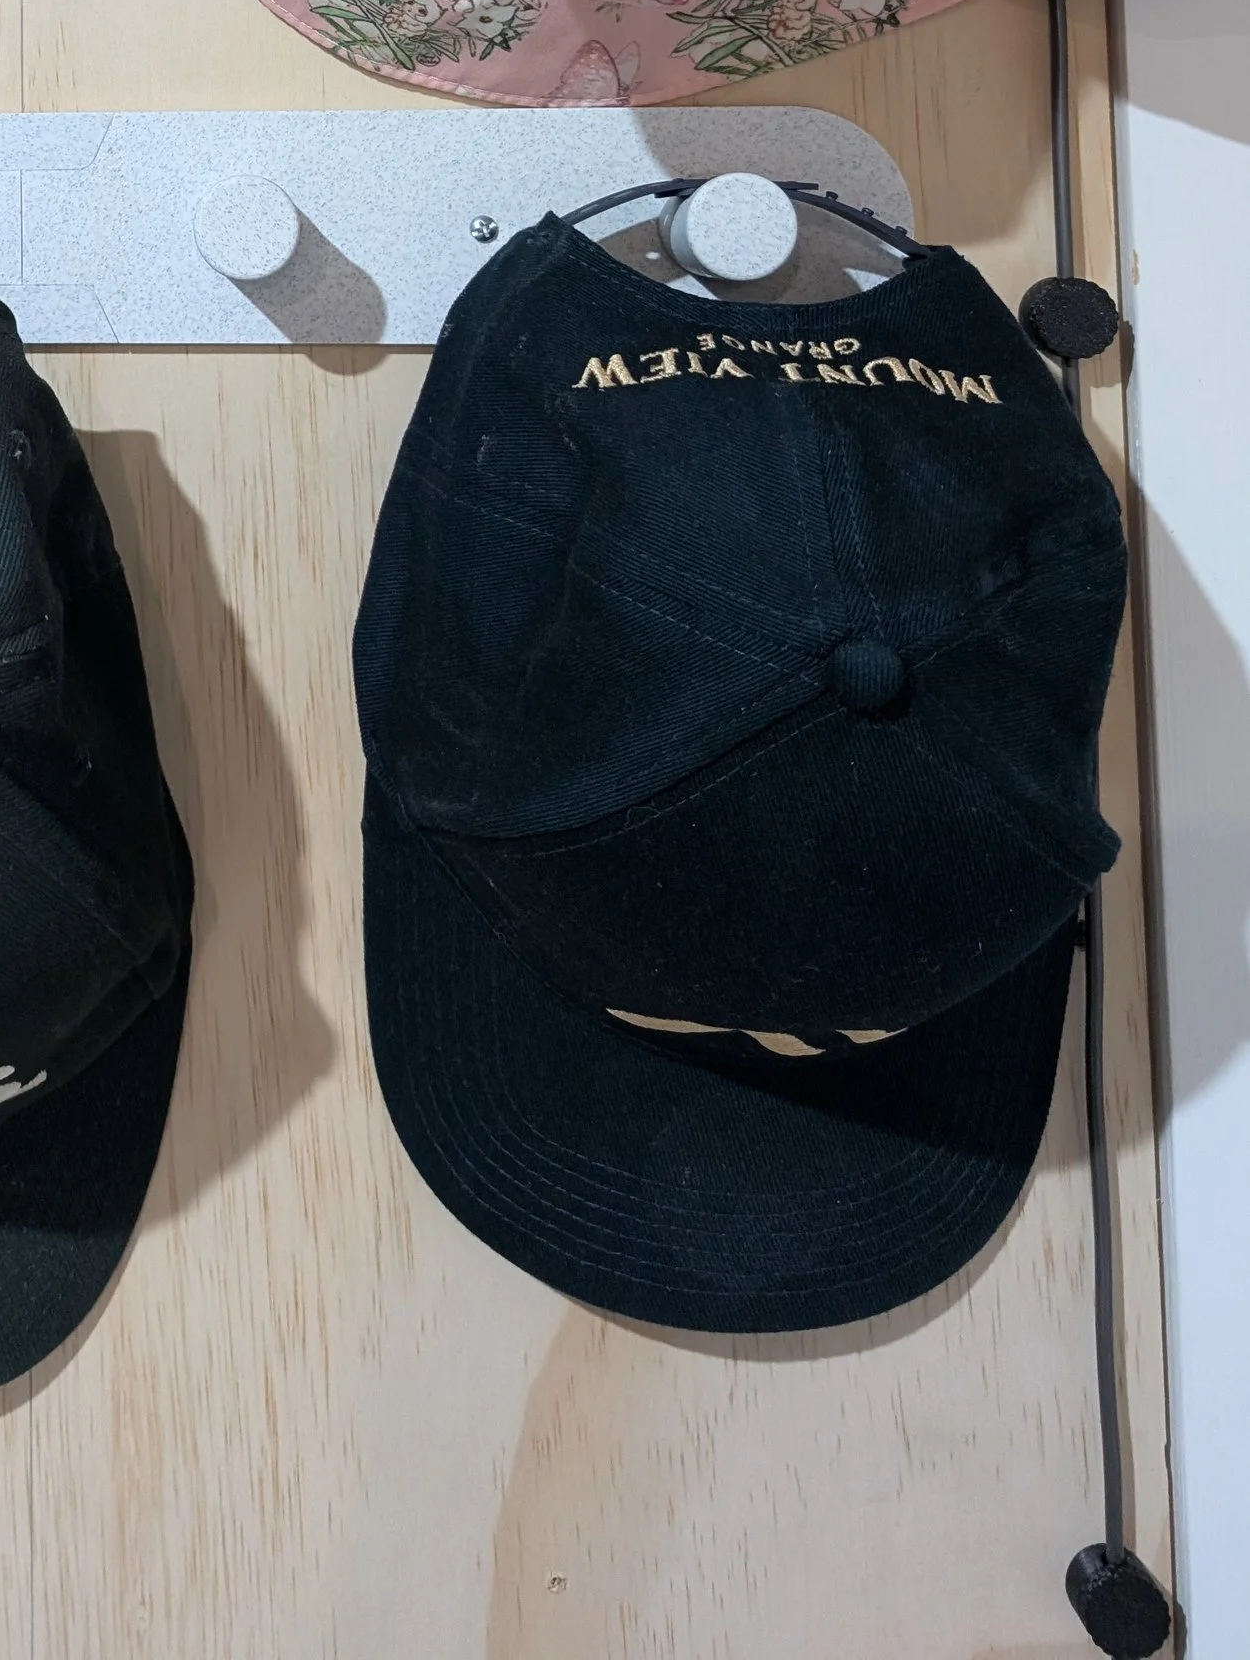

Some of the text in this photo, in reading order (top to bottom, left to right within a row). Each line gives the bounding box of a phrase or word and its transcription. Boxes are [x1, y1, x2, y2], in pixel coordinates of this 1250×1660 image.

[697, 333, 860, 360] GRANGE
[572, 348, 1002, 405] MOUNT VIEW
